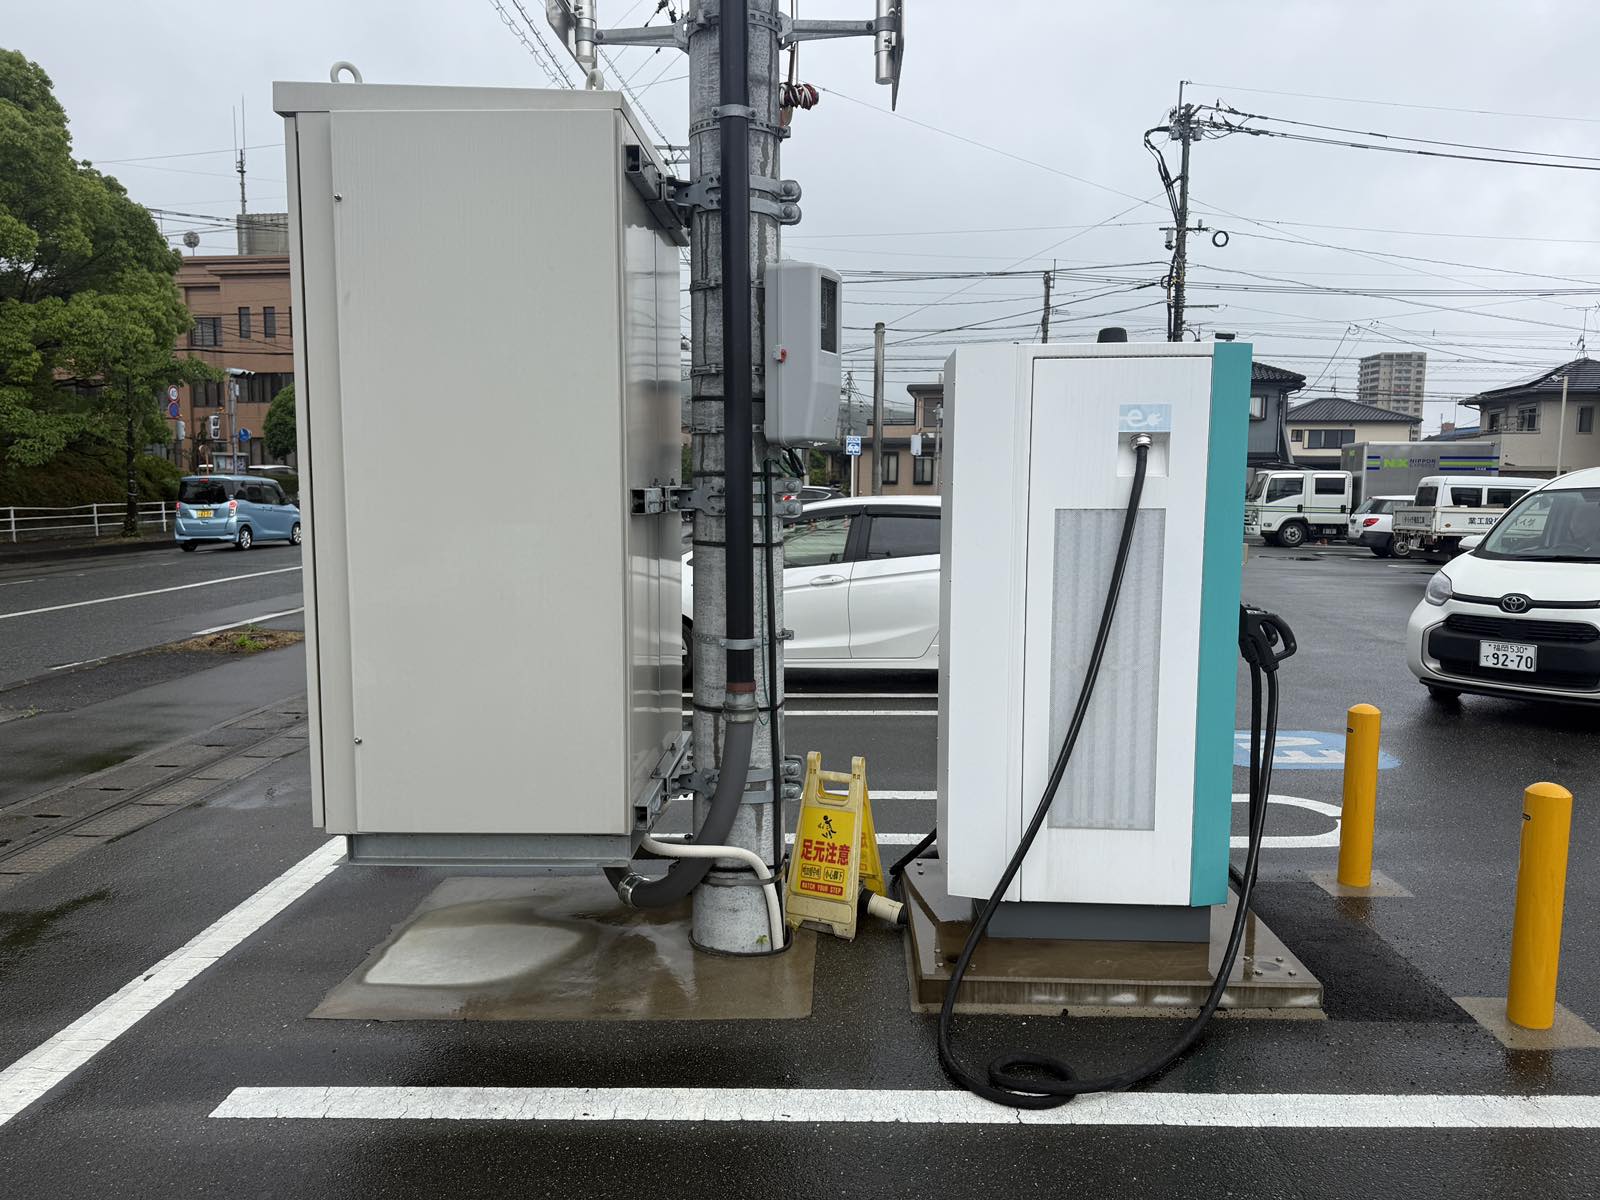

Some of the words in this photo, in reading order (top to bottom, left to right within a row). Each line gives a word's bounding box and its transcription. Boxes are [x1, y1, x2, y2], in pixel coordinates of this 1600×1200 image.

[1492, 652, 1534, 670] 92-70
[801, 839, 850, 866] 足元注意
[830, 885, 842, 895] STEP
